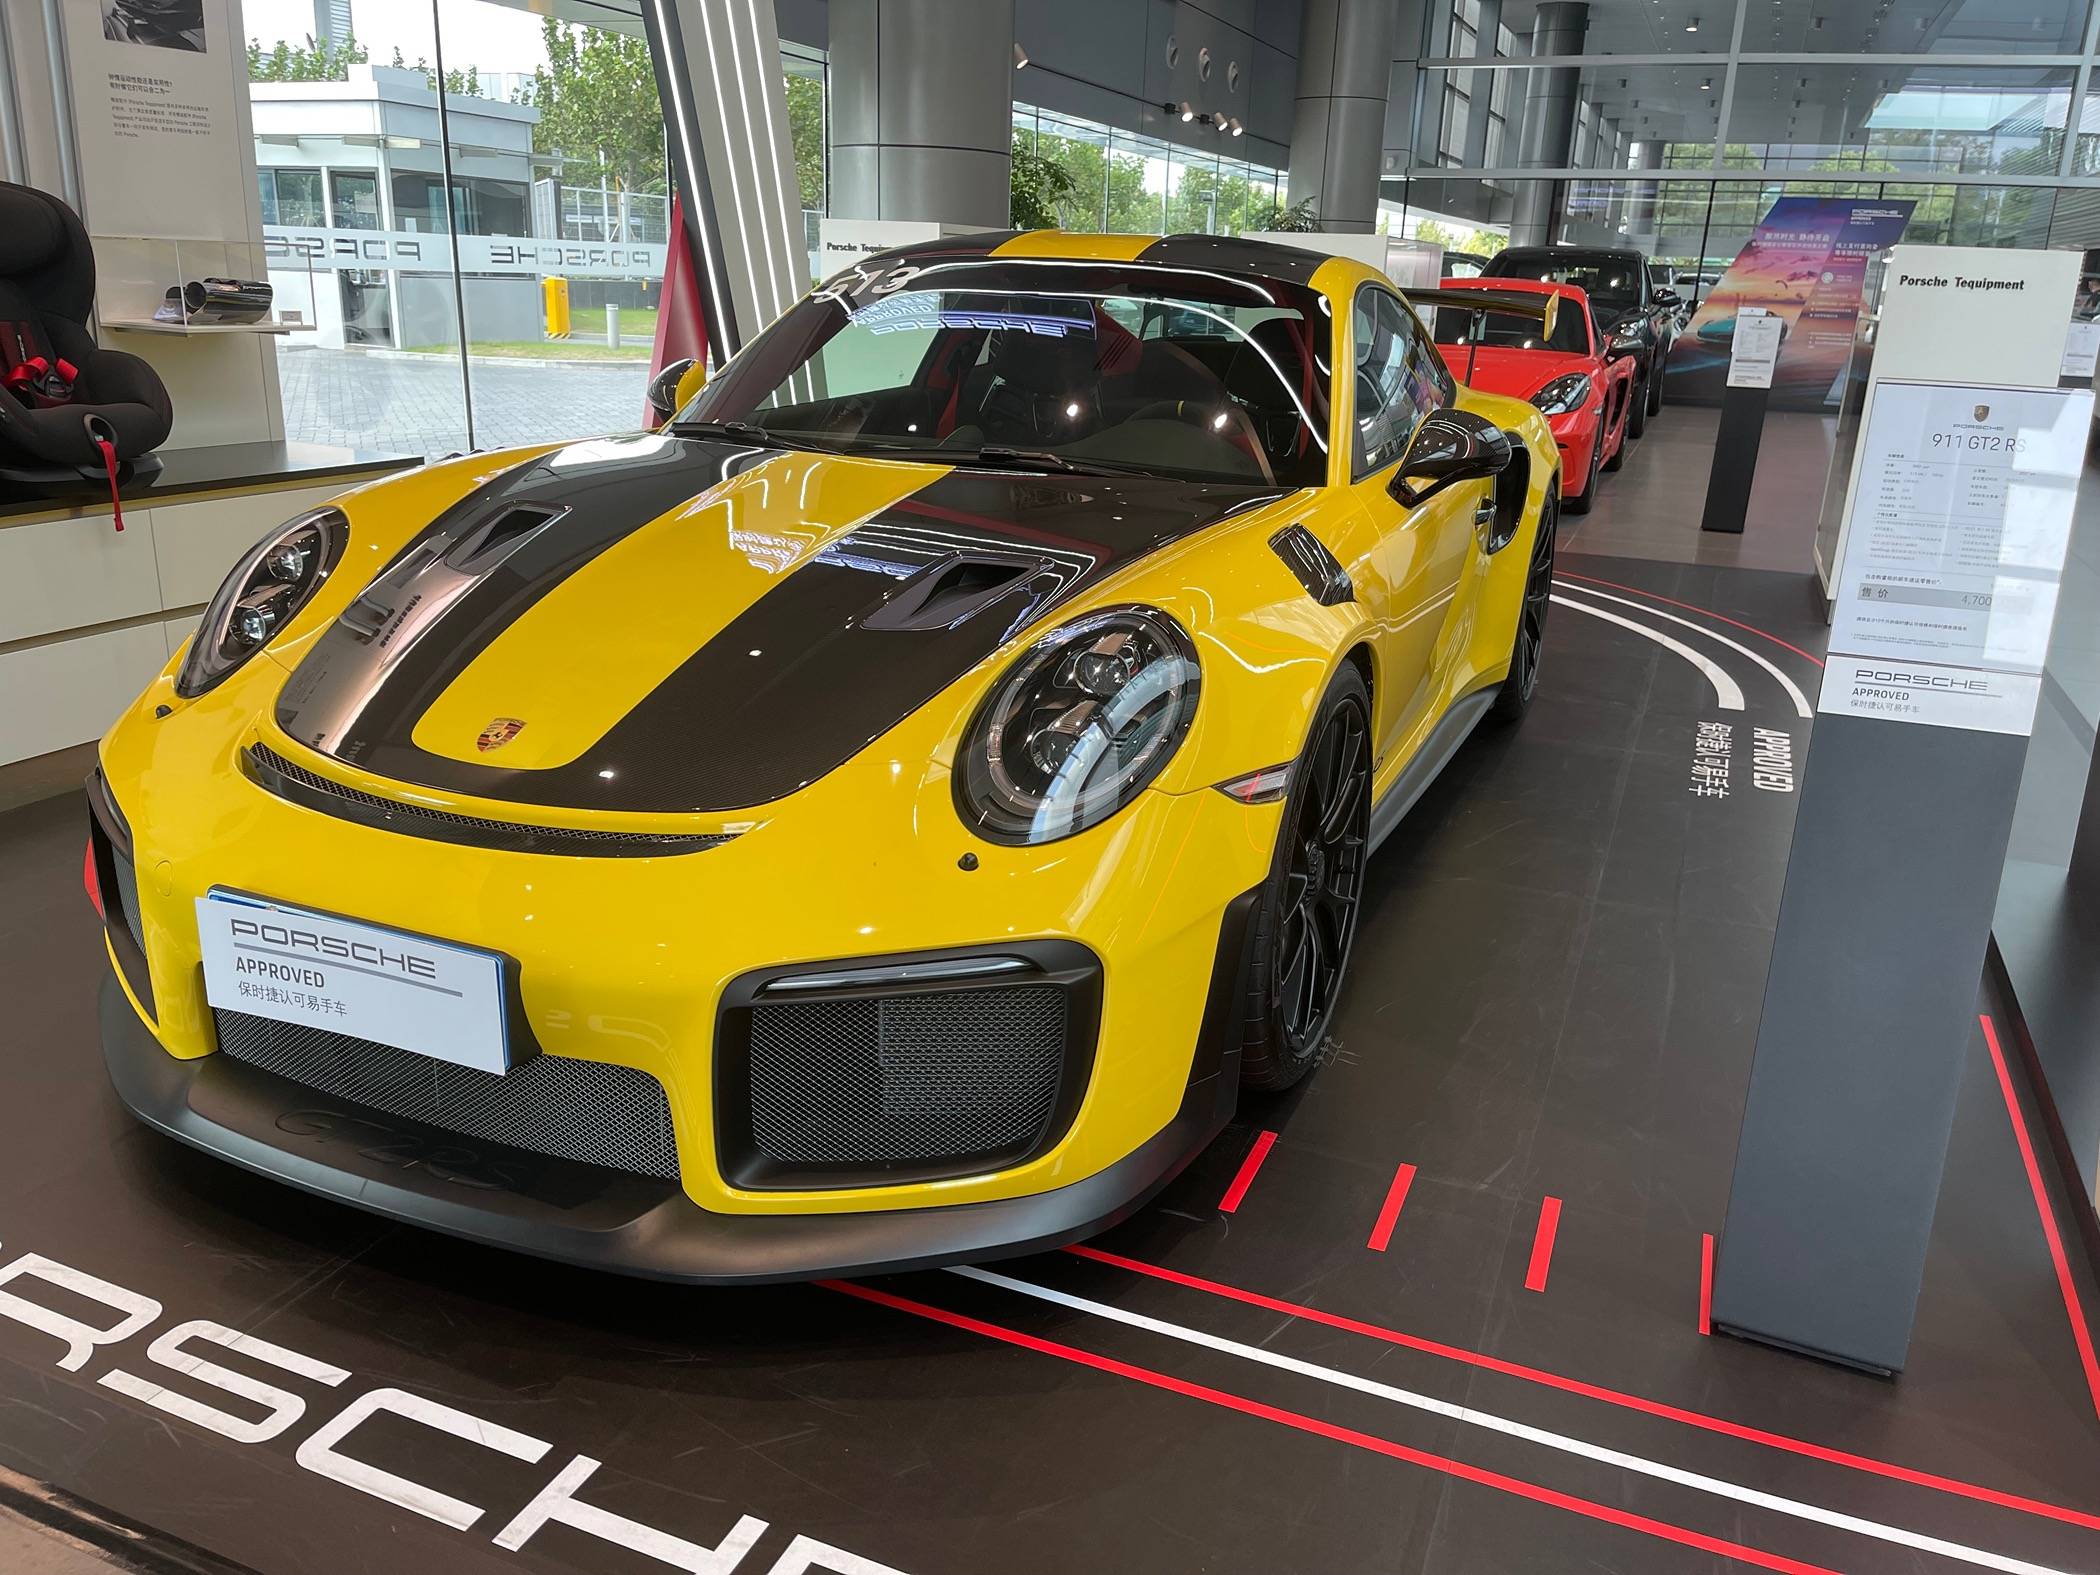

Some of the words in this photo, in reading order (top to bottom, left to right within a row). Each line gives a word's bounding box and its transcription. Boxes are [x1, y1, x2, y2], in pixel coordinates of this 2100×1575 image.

[827, 242, 858, 252] Porsche
[1899, 275, 1948, 287] Porsche
[1954, 276, 2025, 290] Tequipment
[1952, 423, 2005, 432] PORSCHE
[1932, 433, 1962, 448] 911
[1968, 435, 2001, 451] GT2
[1961, 594, 1993, 606] 4,700
[1855, 670, 1989, 691] PORSCHE
[1852, 687, 1910, 701] APPROVED
[1850, 699, 1920, 713] 保时捷认可易手车
[1688, 721, 1733, 799] 保时捷认可易手车
[1752, 727, 1794, 793] APPROVED
[230, 918, 436, 980] PORSCHE
[235, 956, 325, 989] APPROVED
[238, 981, 348, 1017] 保时捷认可易手车
[0, 1239, 912, 1575] RSCH
